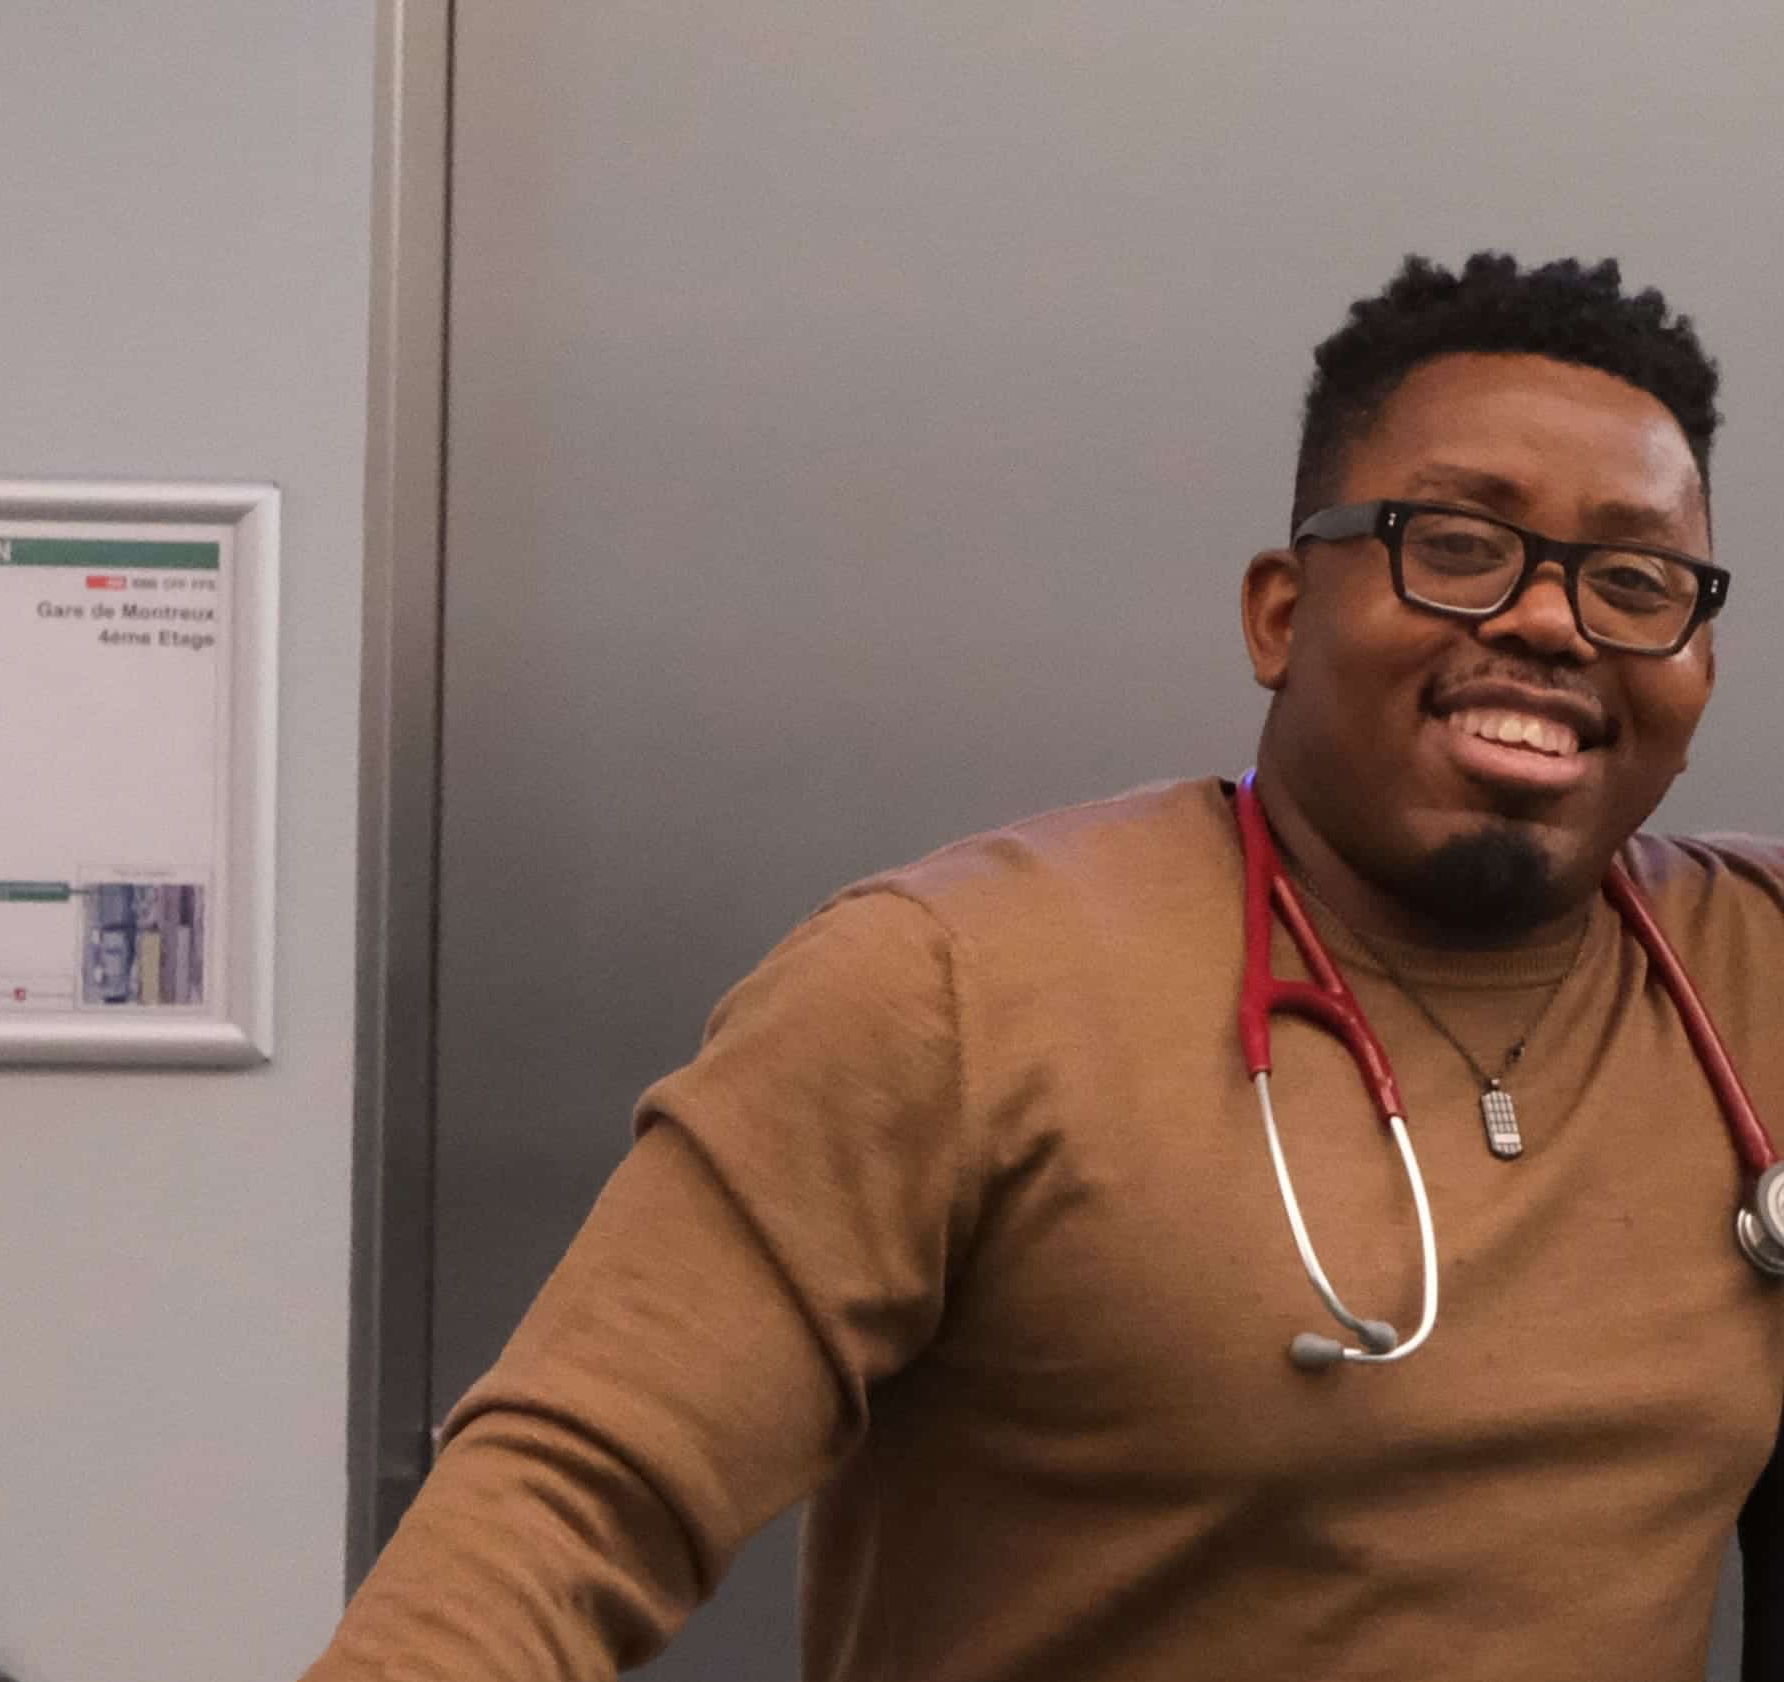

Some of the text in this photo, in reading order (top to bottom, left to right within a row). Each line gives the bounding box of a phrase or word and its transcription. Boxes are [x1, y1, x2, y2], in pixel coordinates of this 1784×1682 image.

[37, 601, 215, 623] Gare de Montreux
